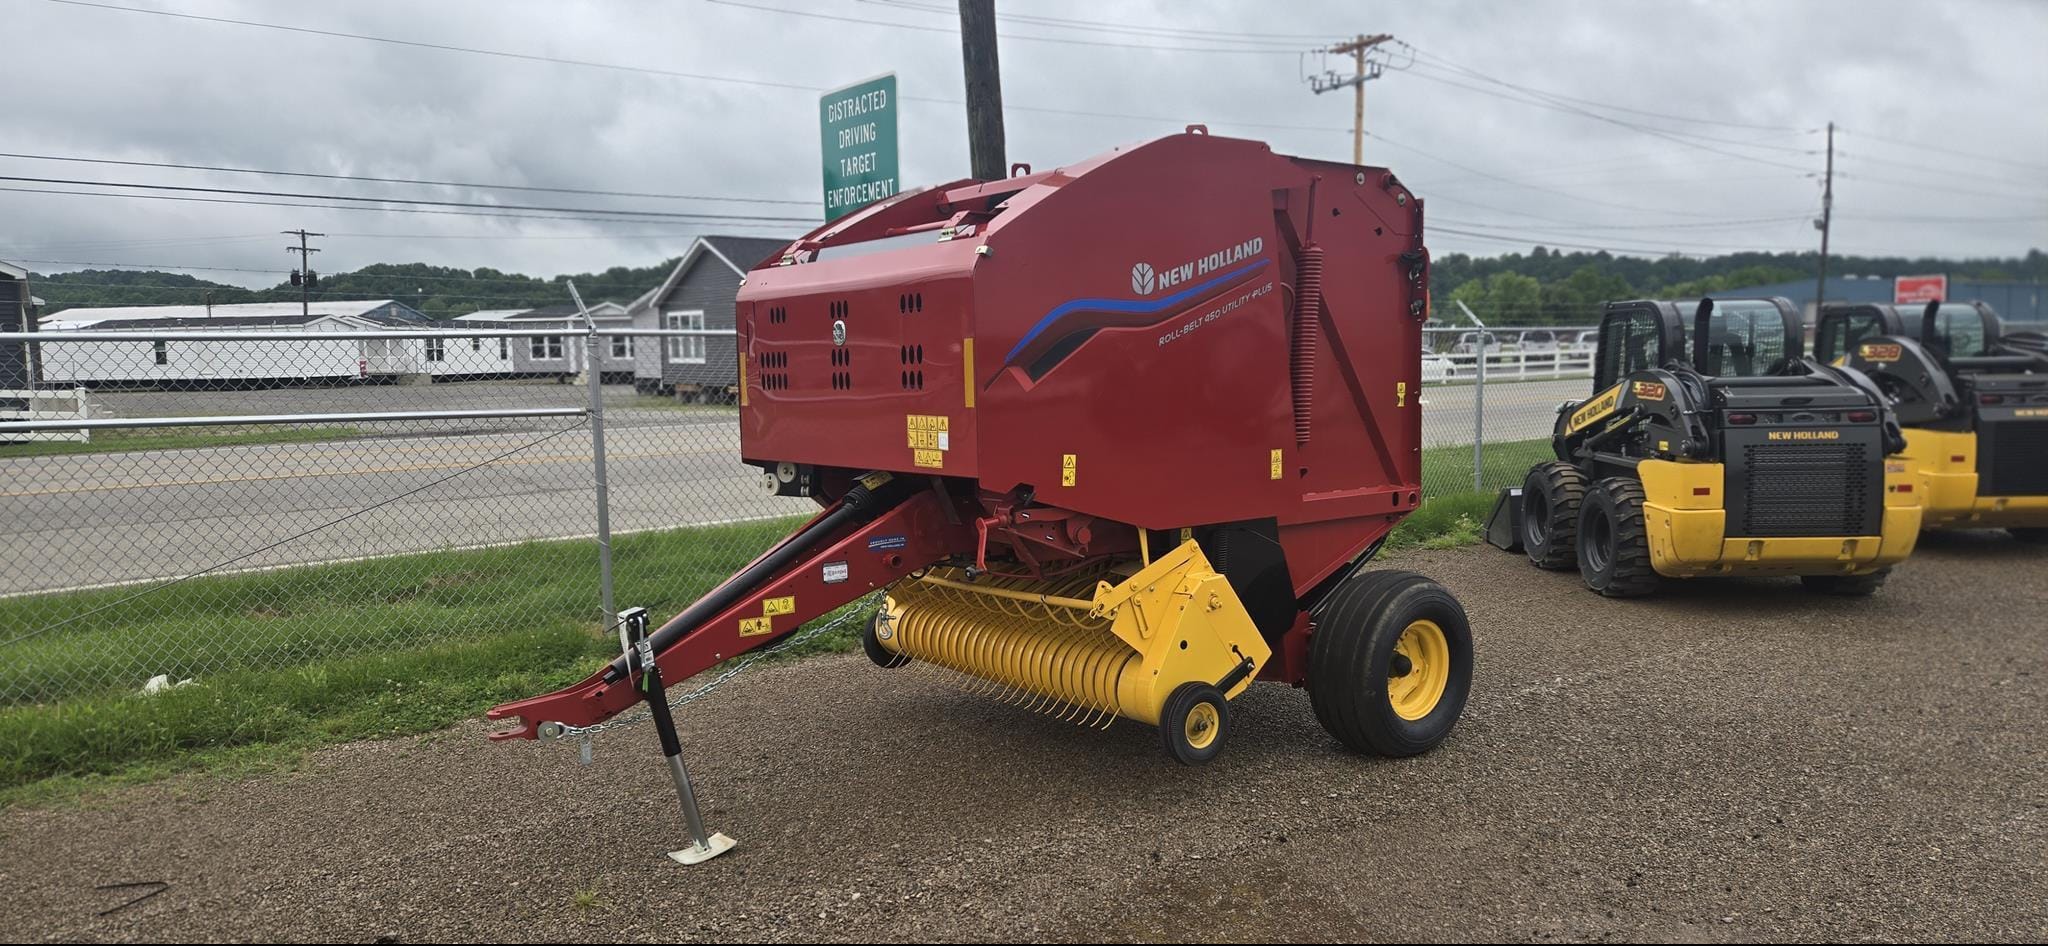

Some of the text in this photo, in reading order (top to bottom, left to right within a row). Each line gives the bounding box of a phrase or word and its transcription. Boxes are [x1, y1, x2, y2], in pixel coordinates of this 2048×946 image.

[828, 89, 886, 123] DISTRACTED
[839, 122, 876, 149] DRIVING
[840, 152, 877, 177] TARGET
[828, 178, 894, 208] ENFORCEMENT
[1158, 237, 1263, 290] NEW HOLLAND
[1158, 317, 1203, 346] ROLL-BELT
[1222, 293, 1250, 314] UTILITY
[1251, 281, 1273, 299] PLUS
[1587, 396, 1614, 417] HOLLAND
[1768, 430, 1839, 440] NEW HOLLAND
